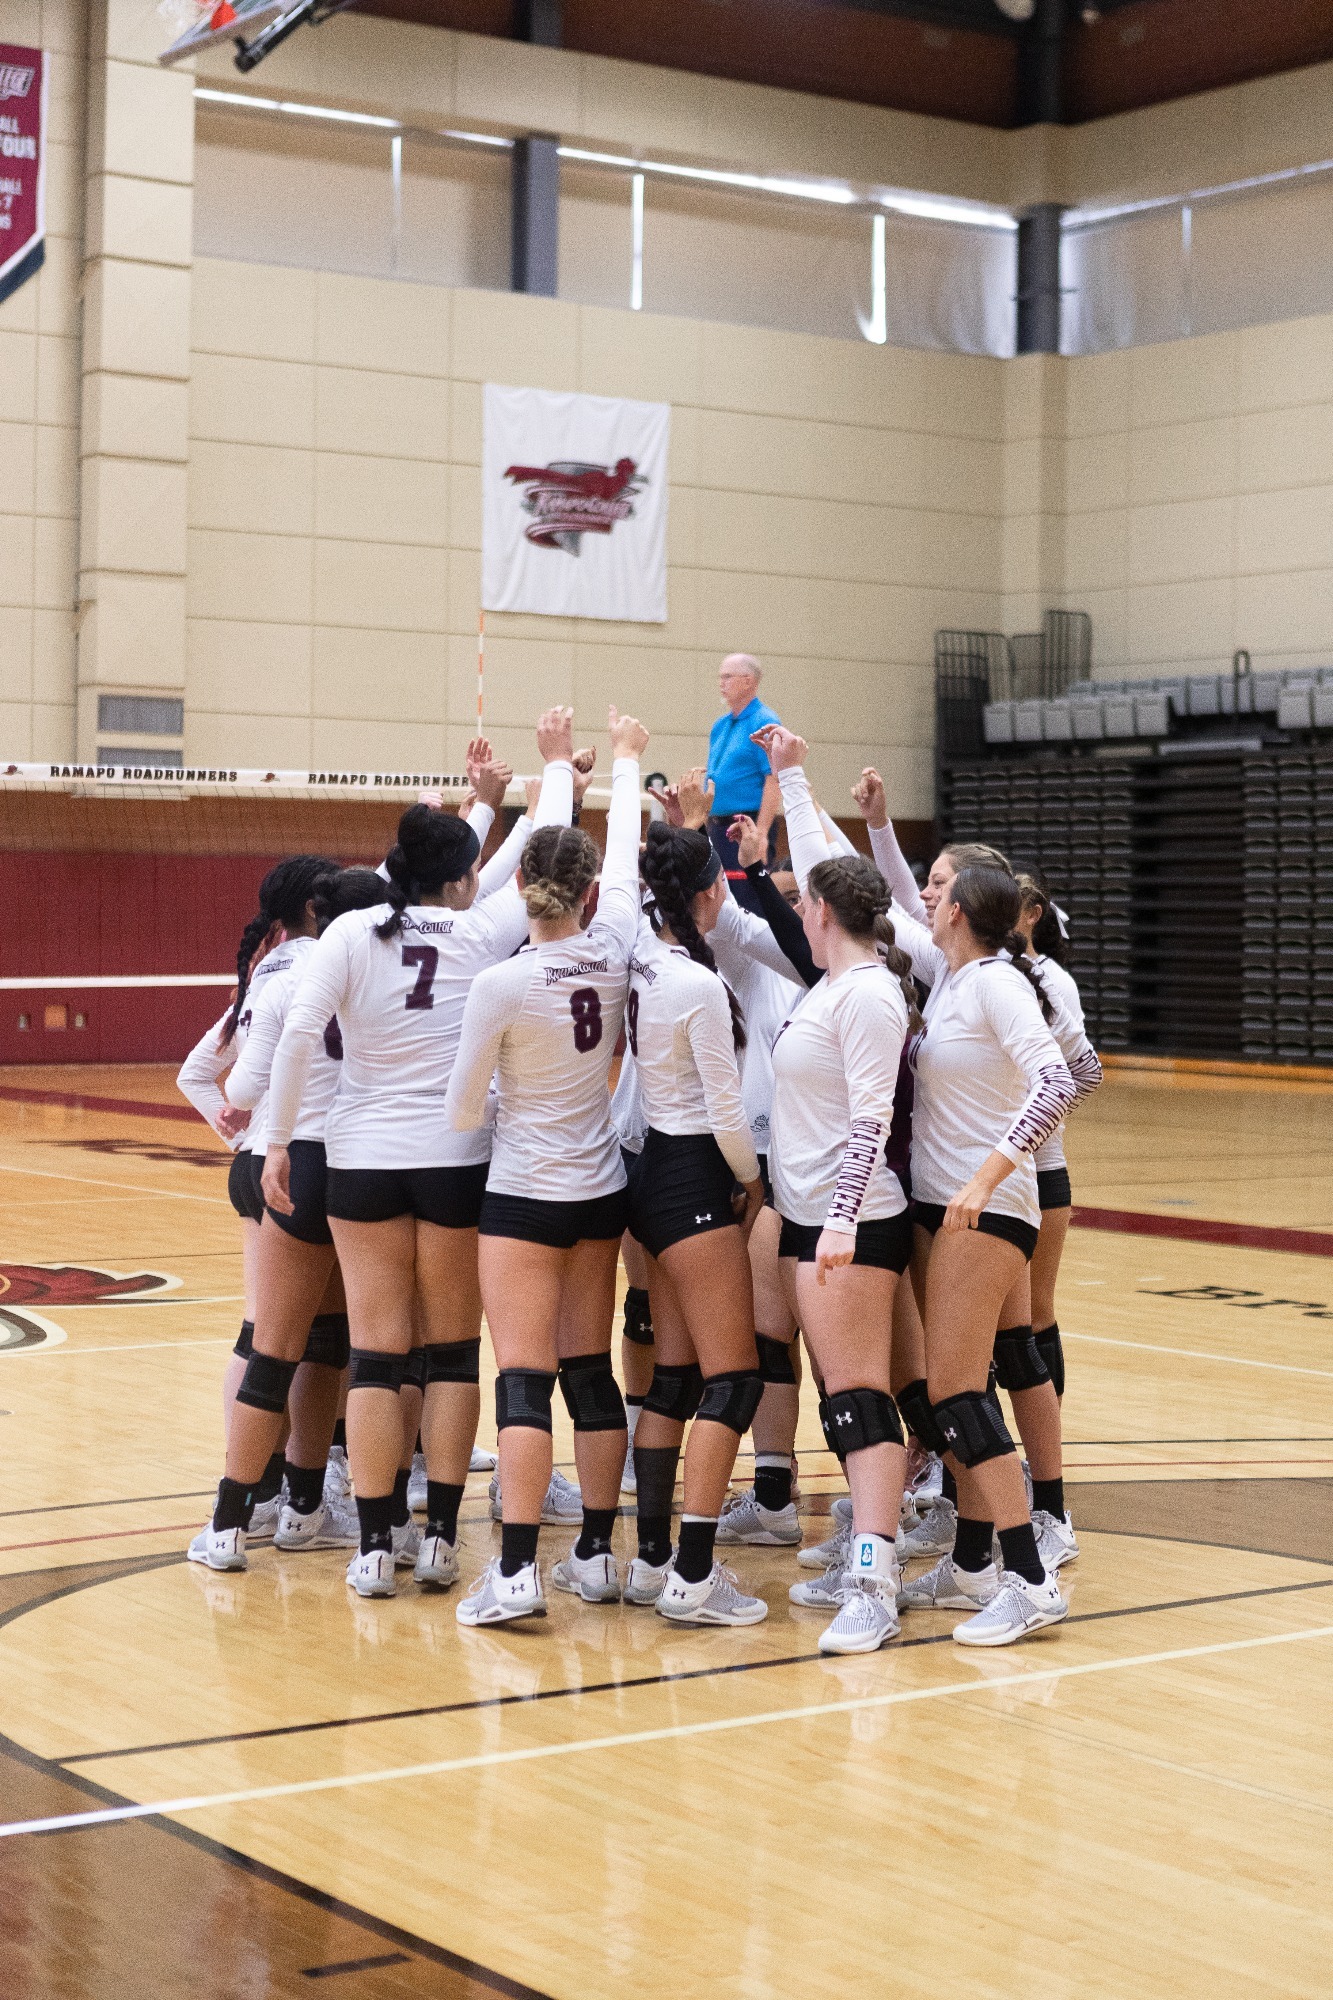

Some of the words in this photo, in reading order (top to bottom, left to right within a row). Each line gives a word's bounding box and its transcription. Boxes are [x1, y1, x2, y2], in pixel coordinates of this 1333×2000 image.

[50, 765, 115, 779] RAMAPO
[122, 767, 238, 783] ROADRUNNERS
[307, 773, 368, 786] RAMAPO
[374, 775, 469, 788] ROADRUNNER
[401, 944, 439, 1010] 7
[569, 986, 603, 1054] 8
